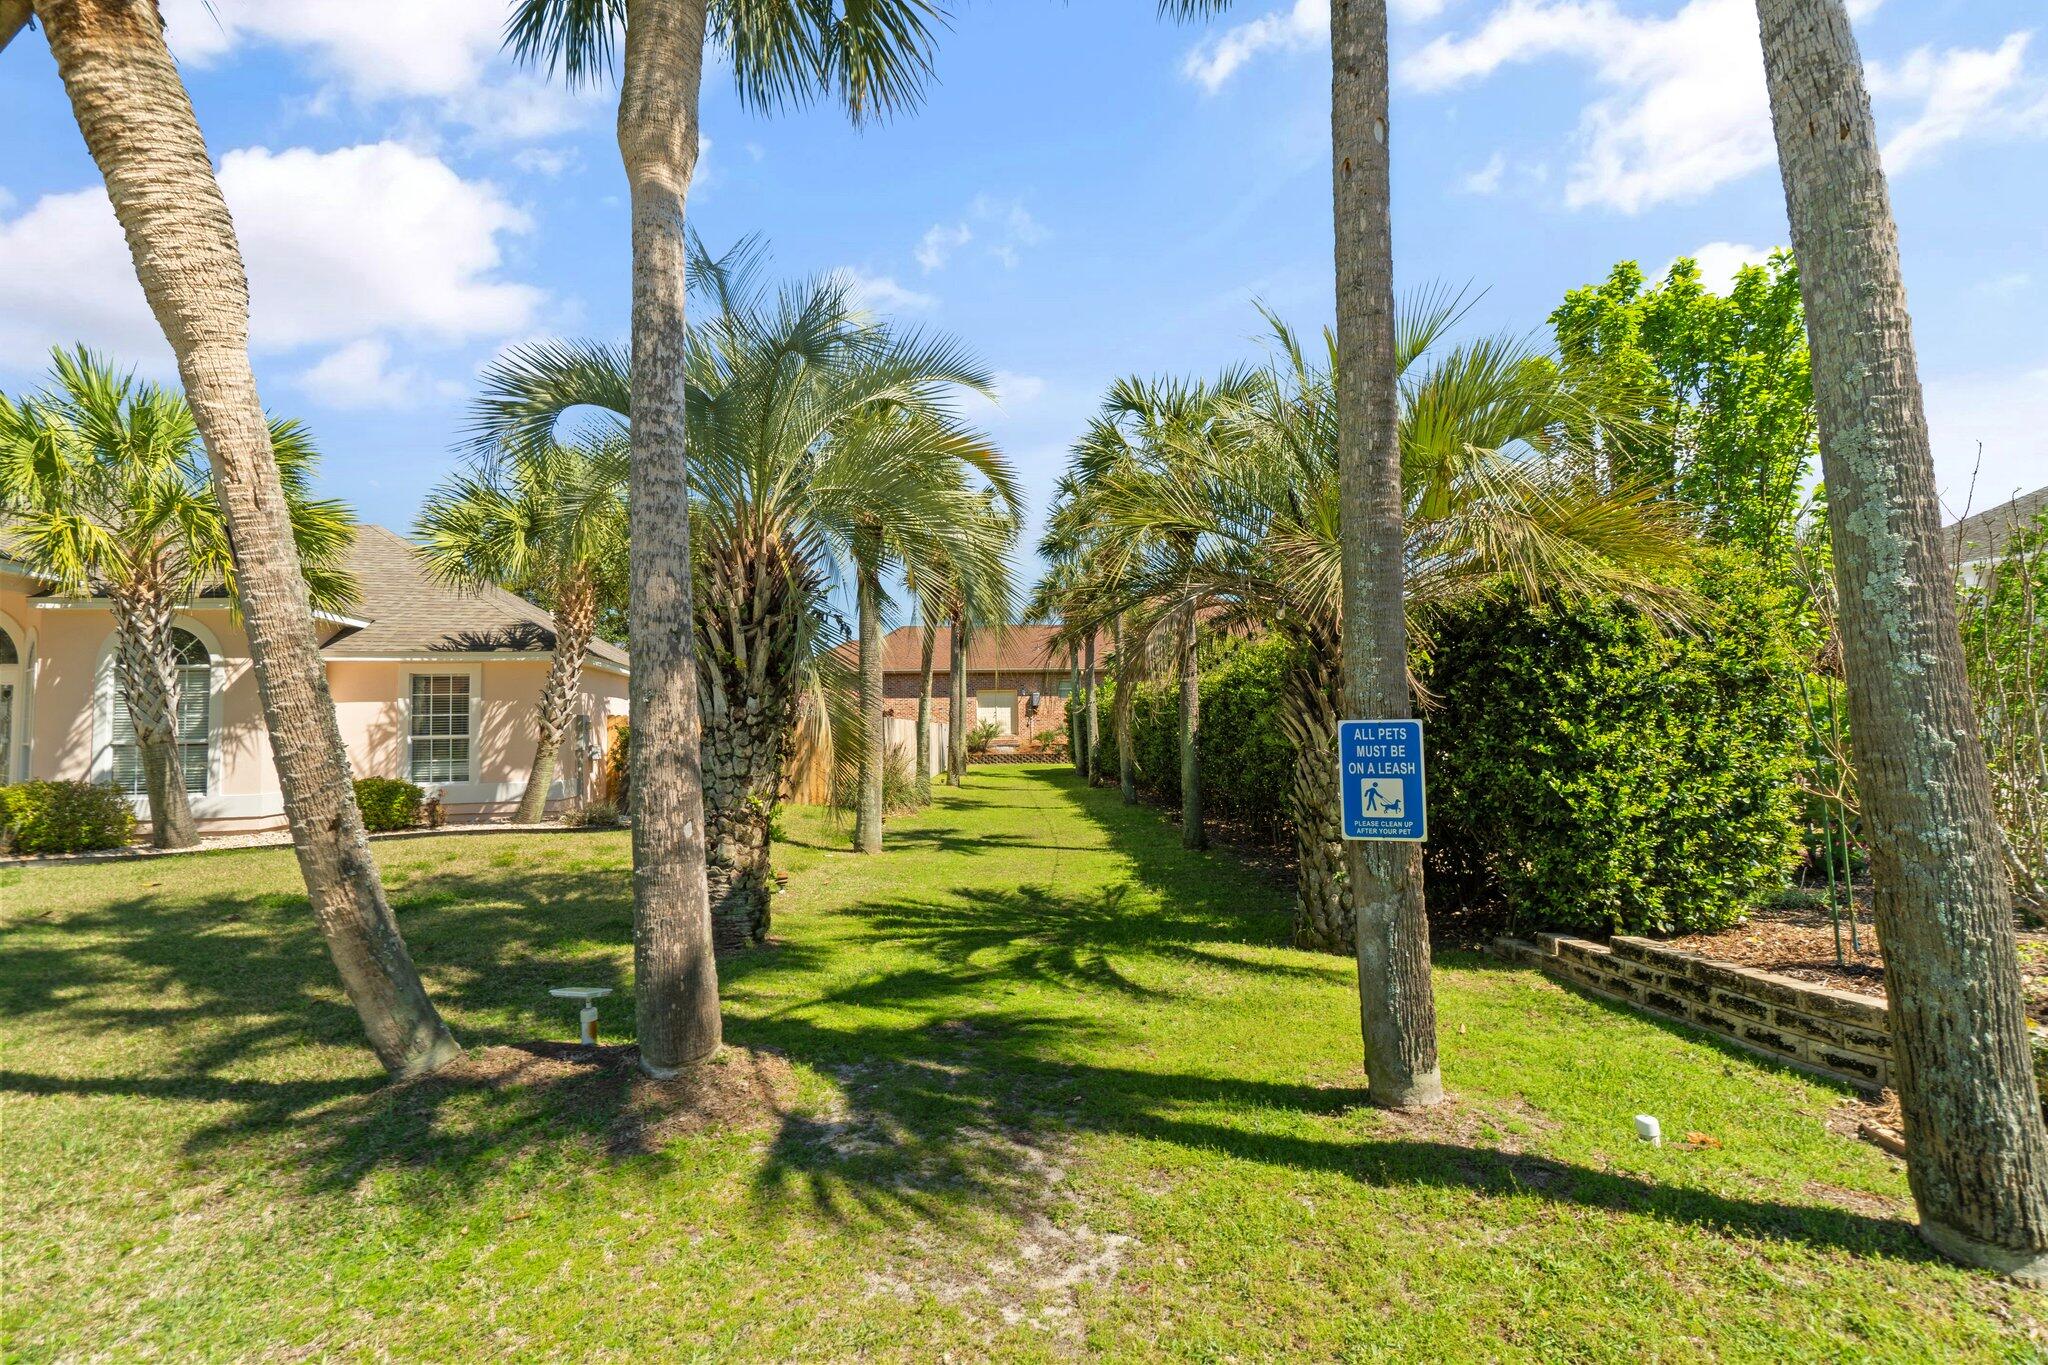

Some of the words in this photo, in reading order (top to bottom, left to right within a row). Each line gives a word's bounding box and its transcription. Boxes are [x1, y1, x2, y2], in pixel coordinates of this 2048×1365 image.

[1354, 728, 1375, 740] ALL
[1378, 728, 1407, 740] PETS
[1356, 745, 1387, 757] MUST
[1391, 745, 1406, 757] BE
[1348, 762, 1364, 774] ON
[1367, 762, 1376, 774] A
[1378, 762, 1415, 774] LEASH
